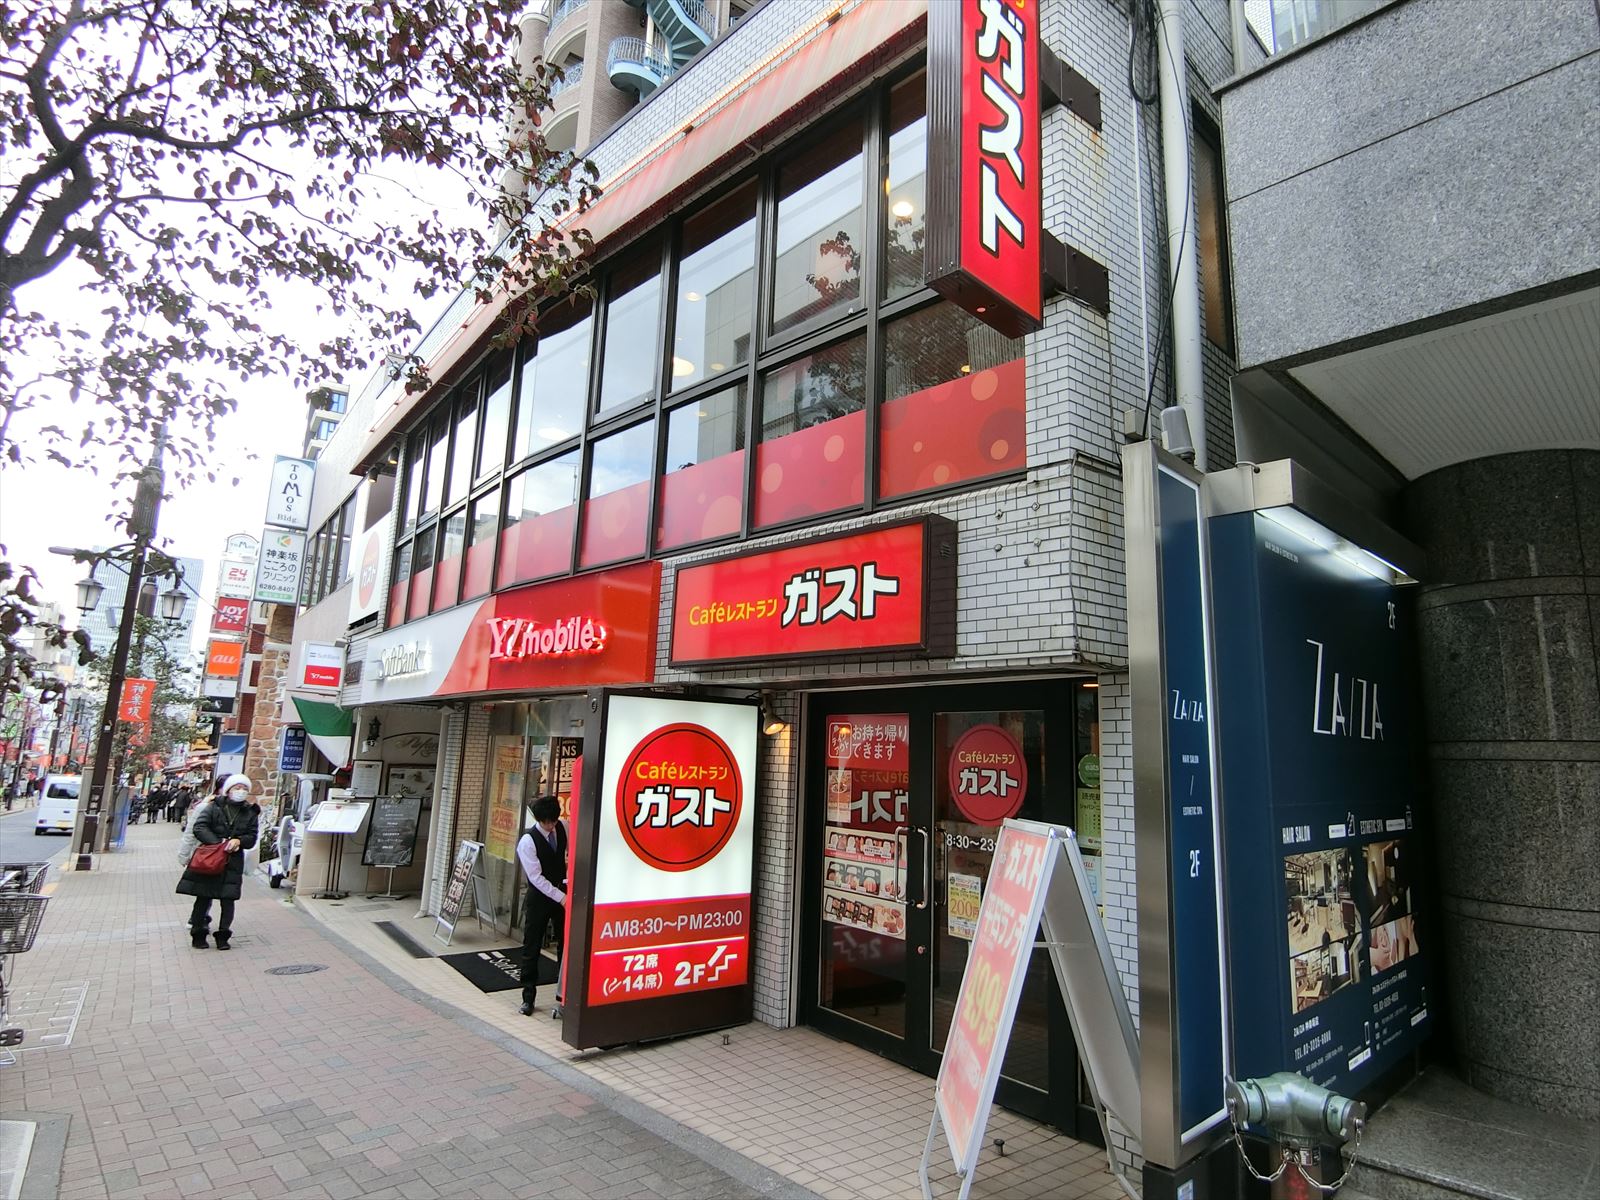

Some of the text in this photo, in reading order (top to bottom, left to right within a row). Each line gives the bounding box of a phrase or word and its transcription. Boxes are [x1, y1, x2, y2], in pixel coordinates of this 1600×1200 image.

[977, 0, 1024, 255] ガスト
[266, 549, 298, 561] 神楽坂
[228, 567, 248, 578] 24
[263, 560, 298, 573] こころの
[263, 571, 296, 583] クリニック
[258, 583, 295, 594] 6280-8407
[689, 562, 900, 629] Caféレストラン ガスト
[218, 614, 244, 624] FIT
[220, 606, 248, 617] JOY
[212, 654, 238, 664] au
[379, 640, 424, 680] SoftBank
[125, 682, 147, 720] 神楽坂
[852, 724, 907, 742] お持ち帰り
[852, 742, 896, 761] できます
[958, 751, 1016, 765] Caféレストラン
[635, 761, 729, 780] Caféレストラン
[958, 767, 1018, 798] ガスト
[633, 784, 732, 828] ガスト
[1282, 826, 1295, 844] HAIR
[1295, 825, 1311, 842] SALON
[1004, 838, 1043, 887] ガスト
[1189, 850, 1201, 878] 2F
[622, 953, 659, 973] 72席
[674, 961, 706, 987] 2F
